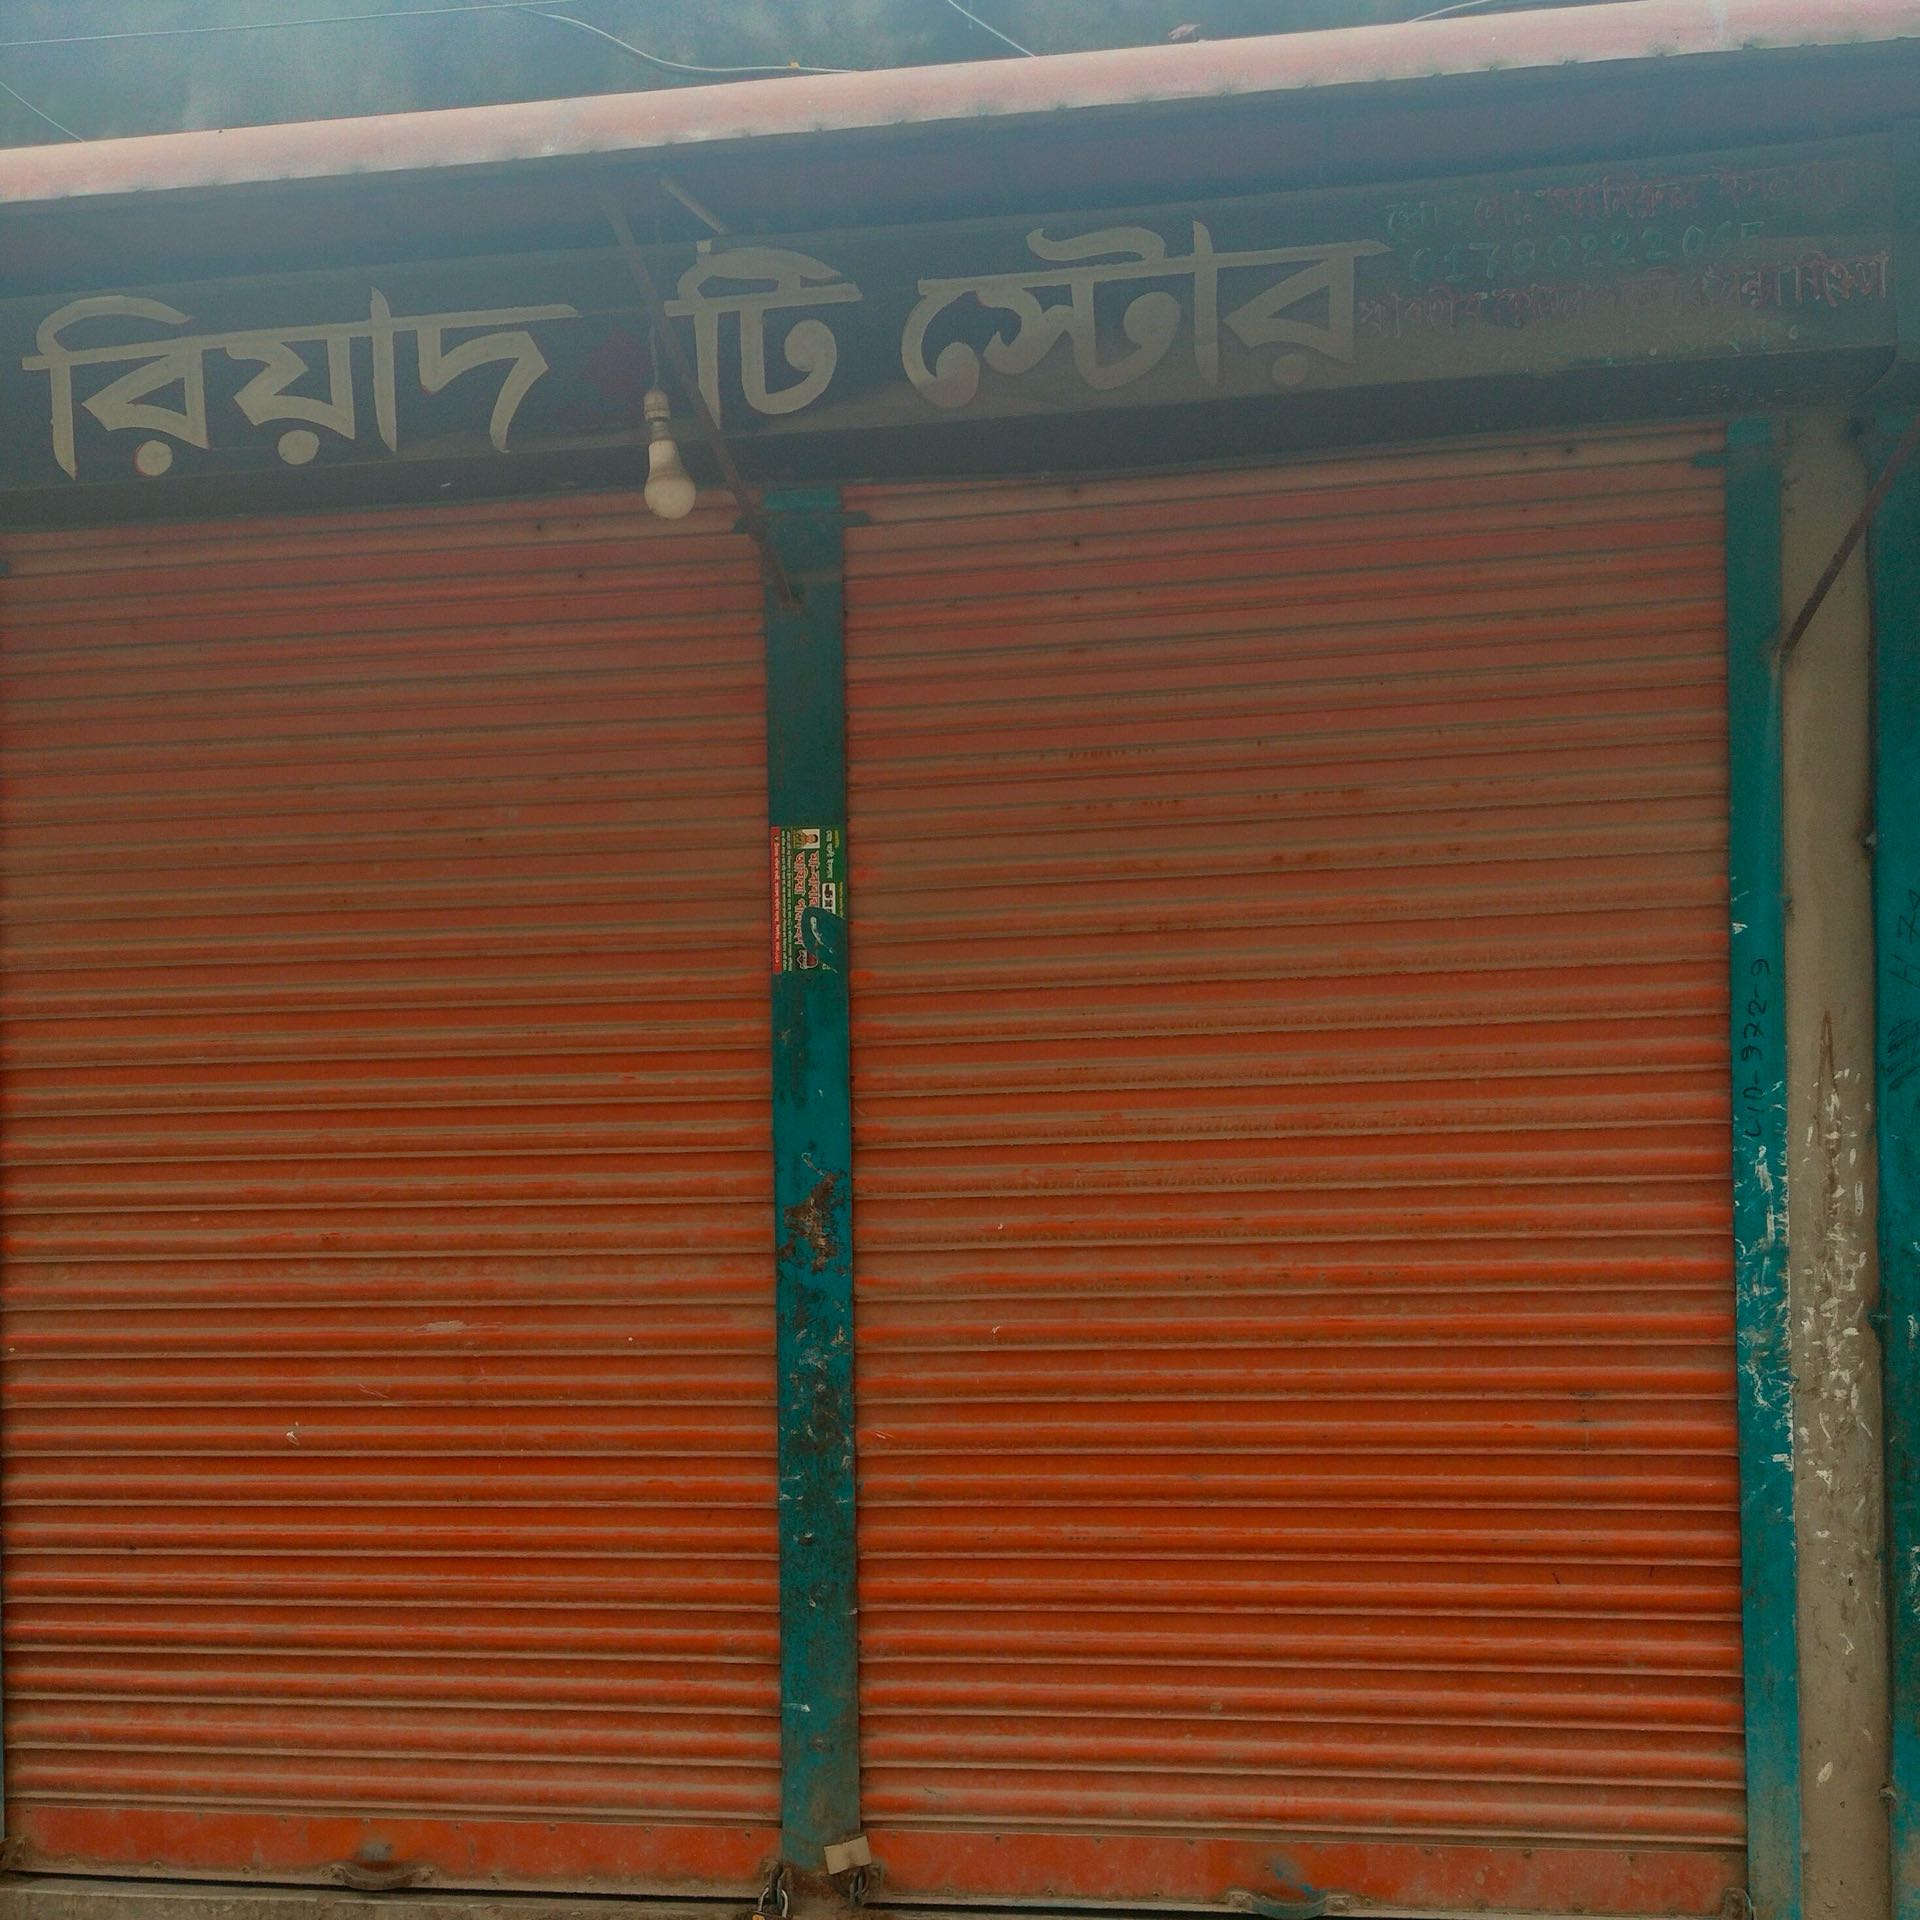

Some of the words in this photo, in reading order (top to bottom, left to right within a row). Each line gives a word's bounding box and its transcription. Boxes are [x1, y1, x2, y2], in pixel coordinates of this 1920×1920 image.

[22, 286, 582, 480] রিয়াদ
[664, 240, 862, 431] টি
[901, 221, 1392, 407] স্টোর
